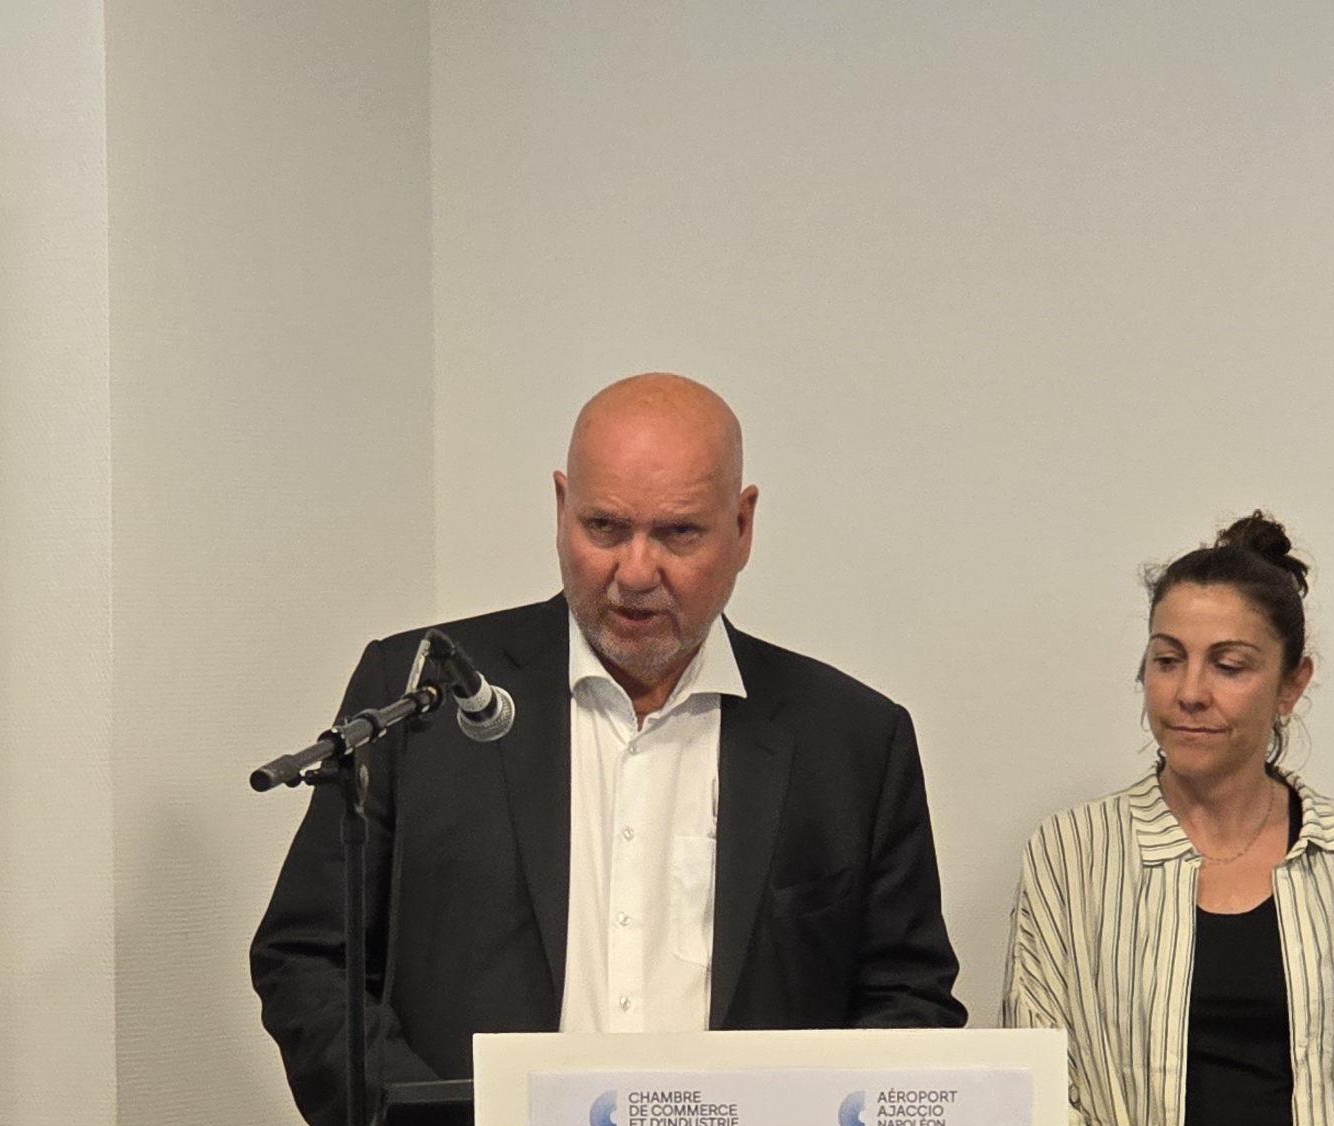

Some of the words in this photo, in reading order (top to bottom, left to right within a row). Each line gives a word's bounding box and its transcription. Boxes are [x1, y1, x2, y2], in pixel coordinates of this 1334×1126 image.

[628, 1091, 701, 1104] CHAMBRE
[877, 1088, 958, 1103] AÉROPORT
[629, 1104, 648, 1117] DE
[651, 1104, 738, 1116] COMMERCE
[877, 1105, 944, 1117] AJACCIO
